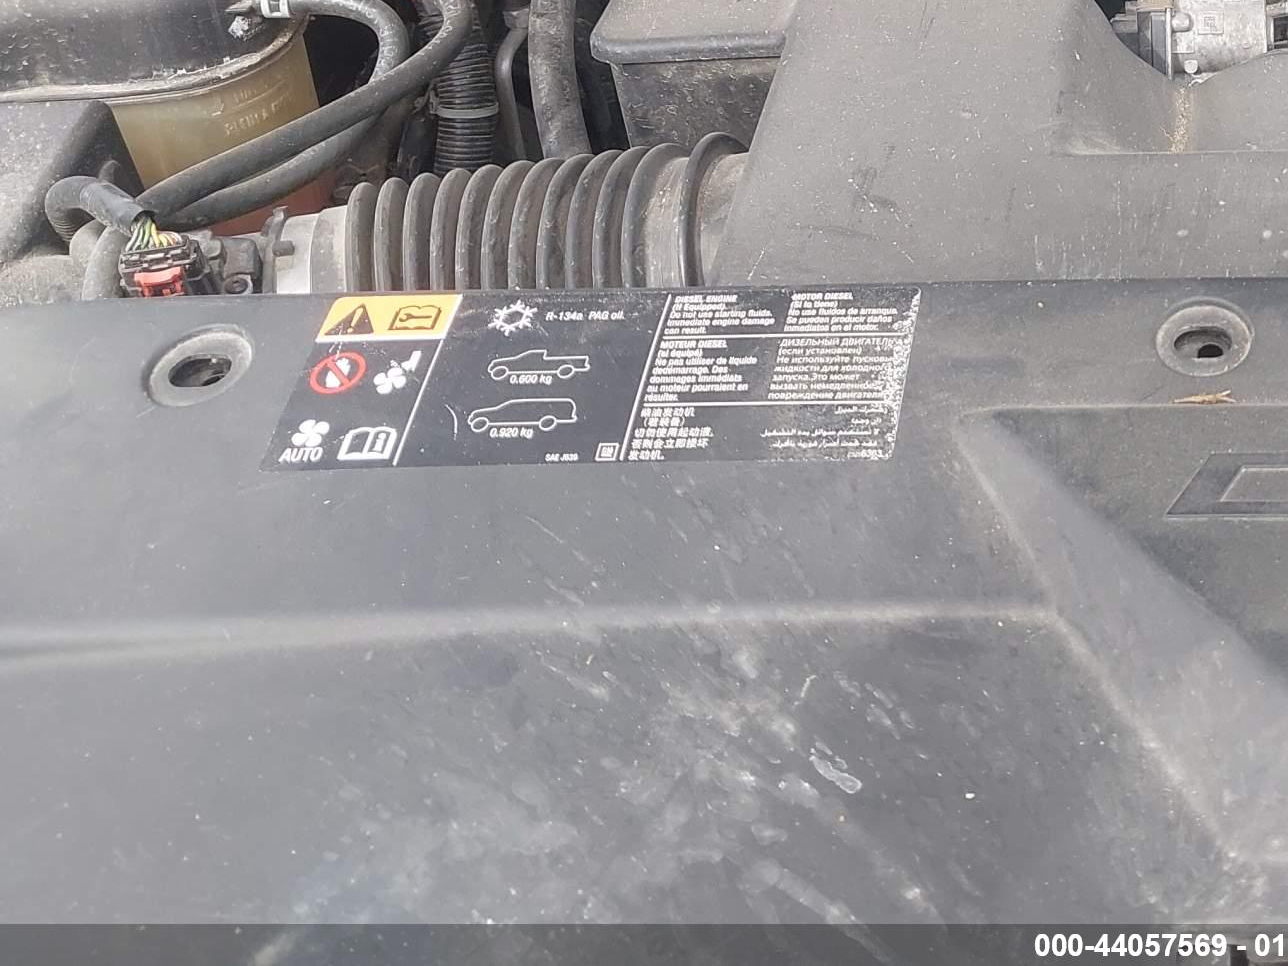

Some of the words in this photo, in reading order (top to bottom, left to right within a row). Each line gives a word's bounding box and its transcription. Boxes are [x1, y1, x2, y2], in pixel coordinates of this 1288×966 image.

[588, 311, 609, 320] PAG
[509, 374, 537, 384] 0.600
[539, 374, 552, 386] kg
[520, 427, 534, 440] kg
[278, 447, 324, 463] AUTO
